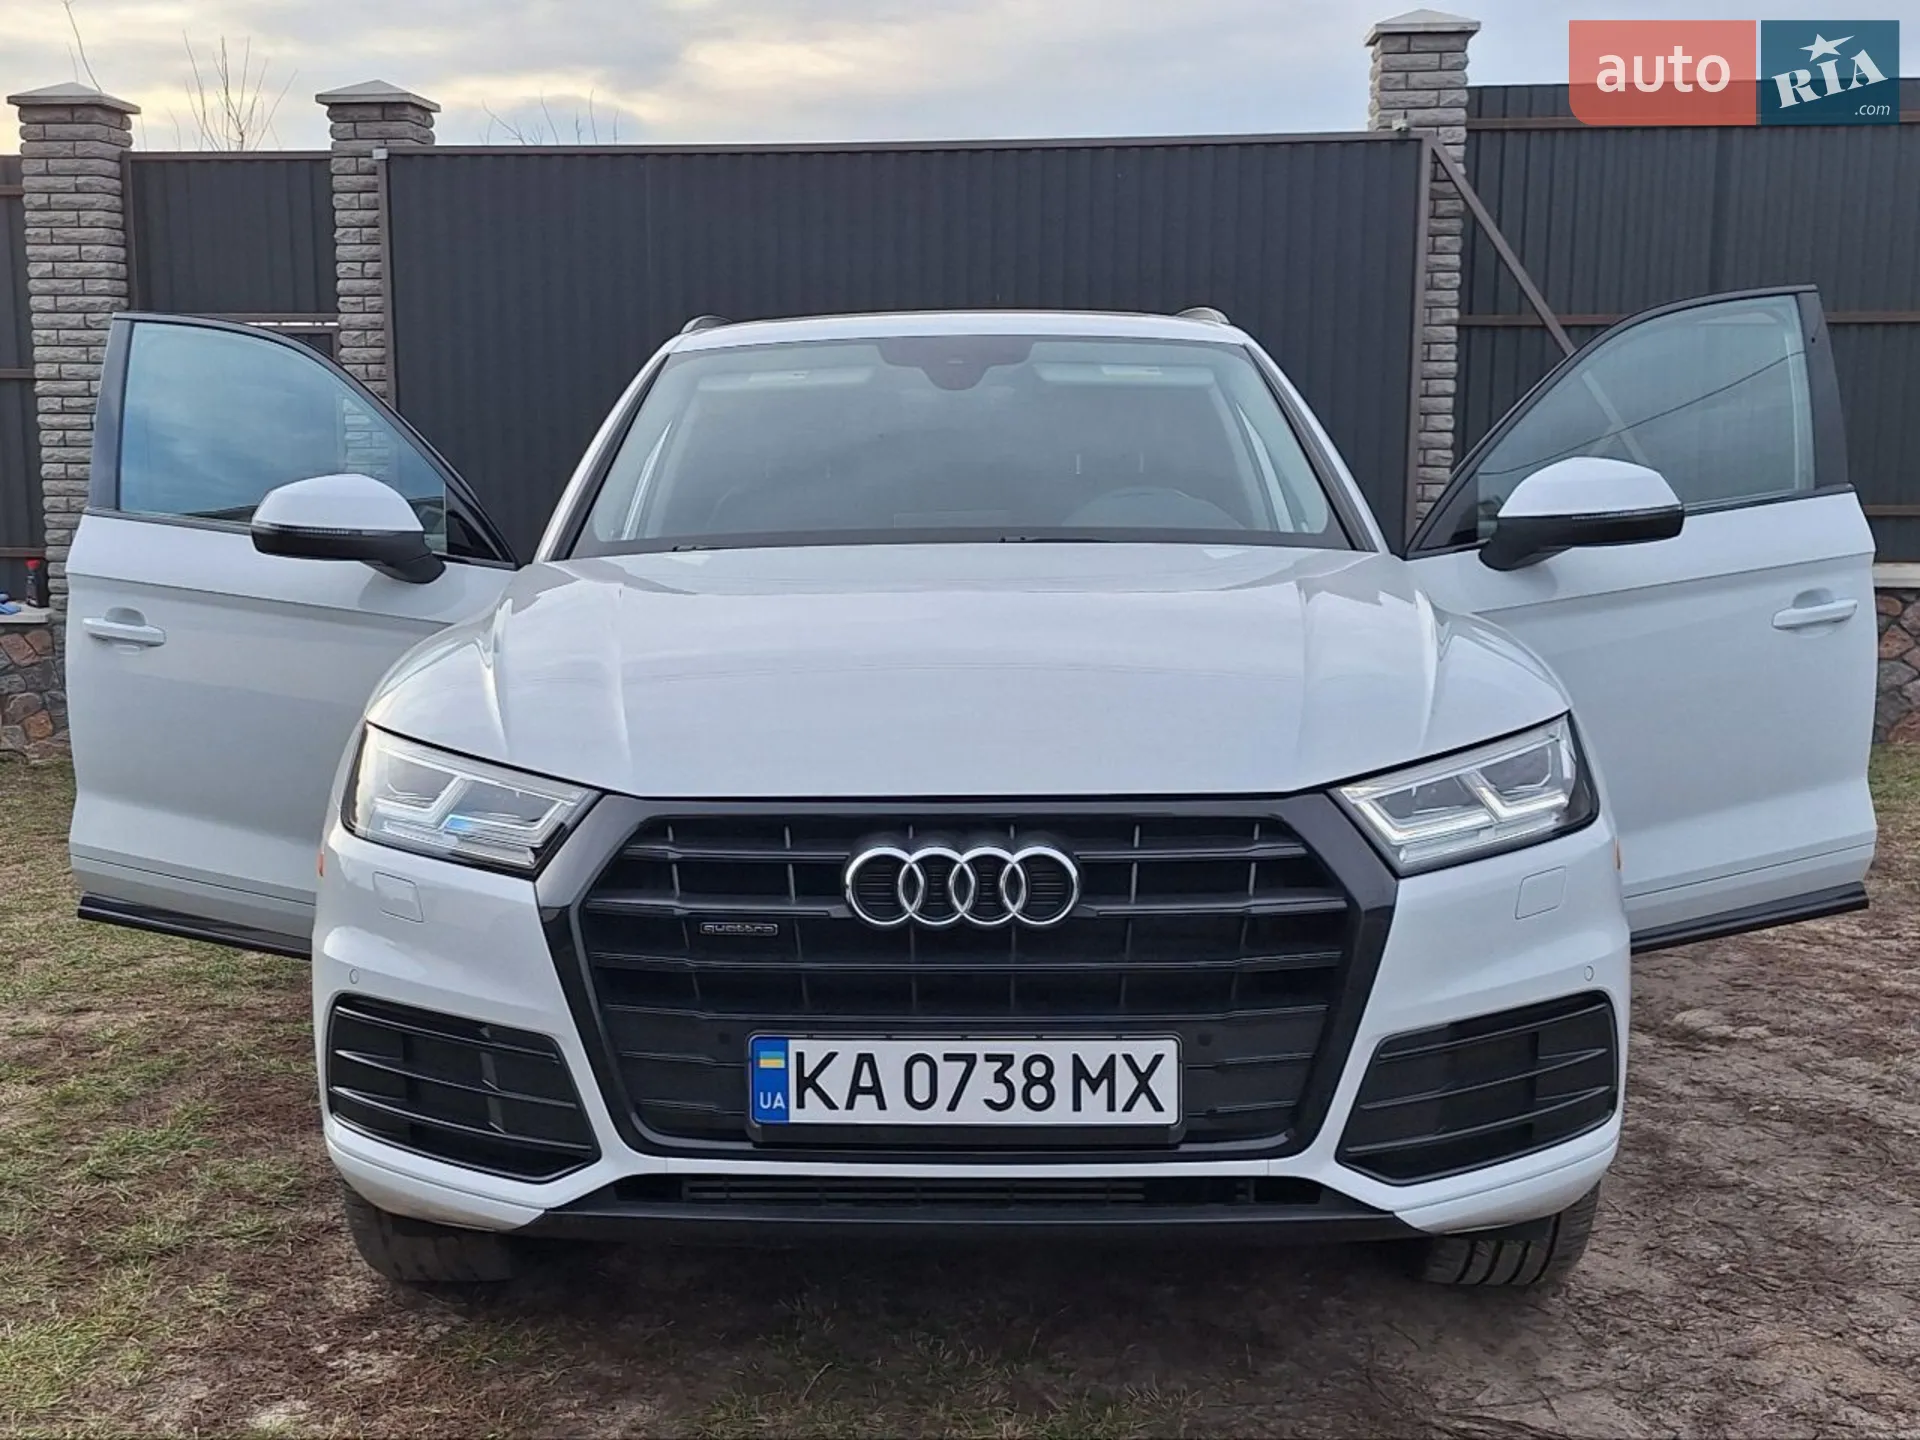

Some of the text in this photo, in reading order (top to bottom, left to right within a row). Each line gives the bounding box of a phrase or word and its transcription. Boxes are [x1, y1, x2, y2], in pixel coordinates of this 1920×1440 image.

[703, 924, 774, 933] quattro
[796, 1051, 1165, 1113] KA 0738 MX
[760, 1092, 786, 1110] UA
